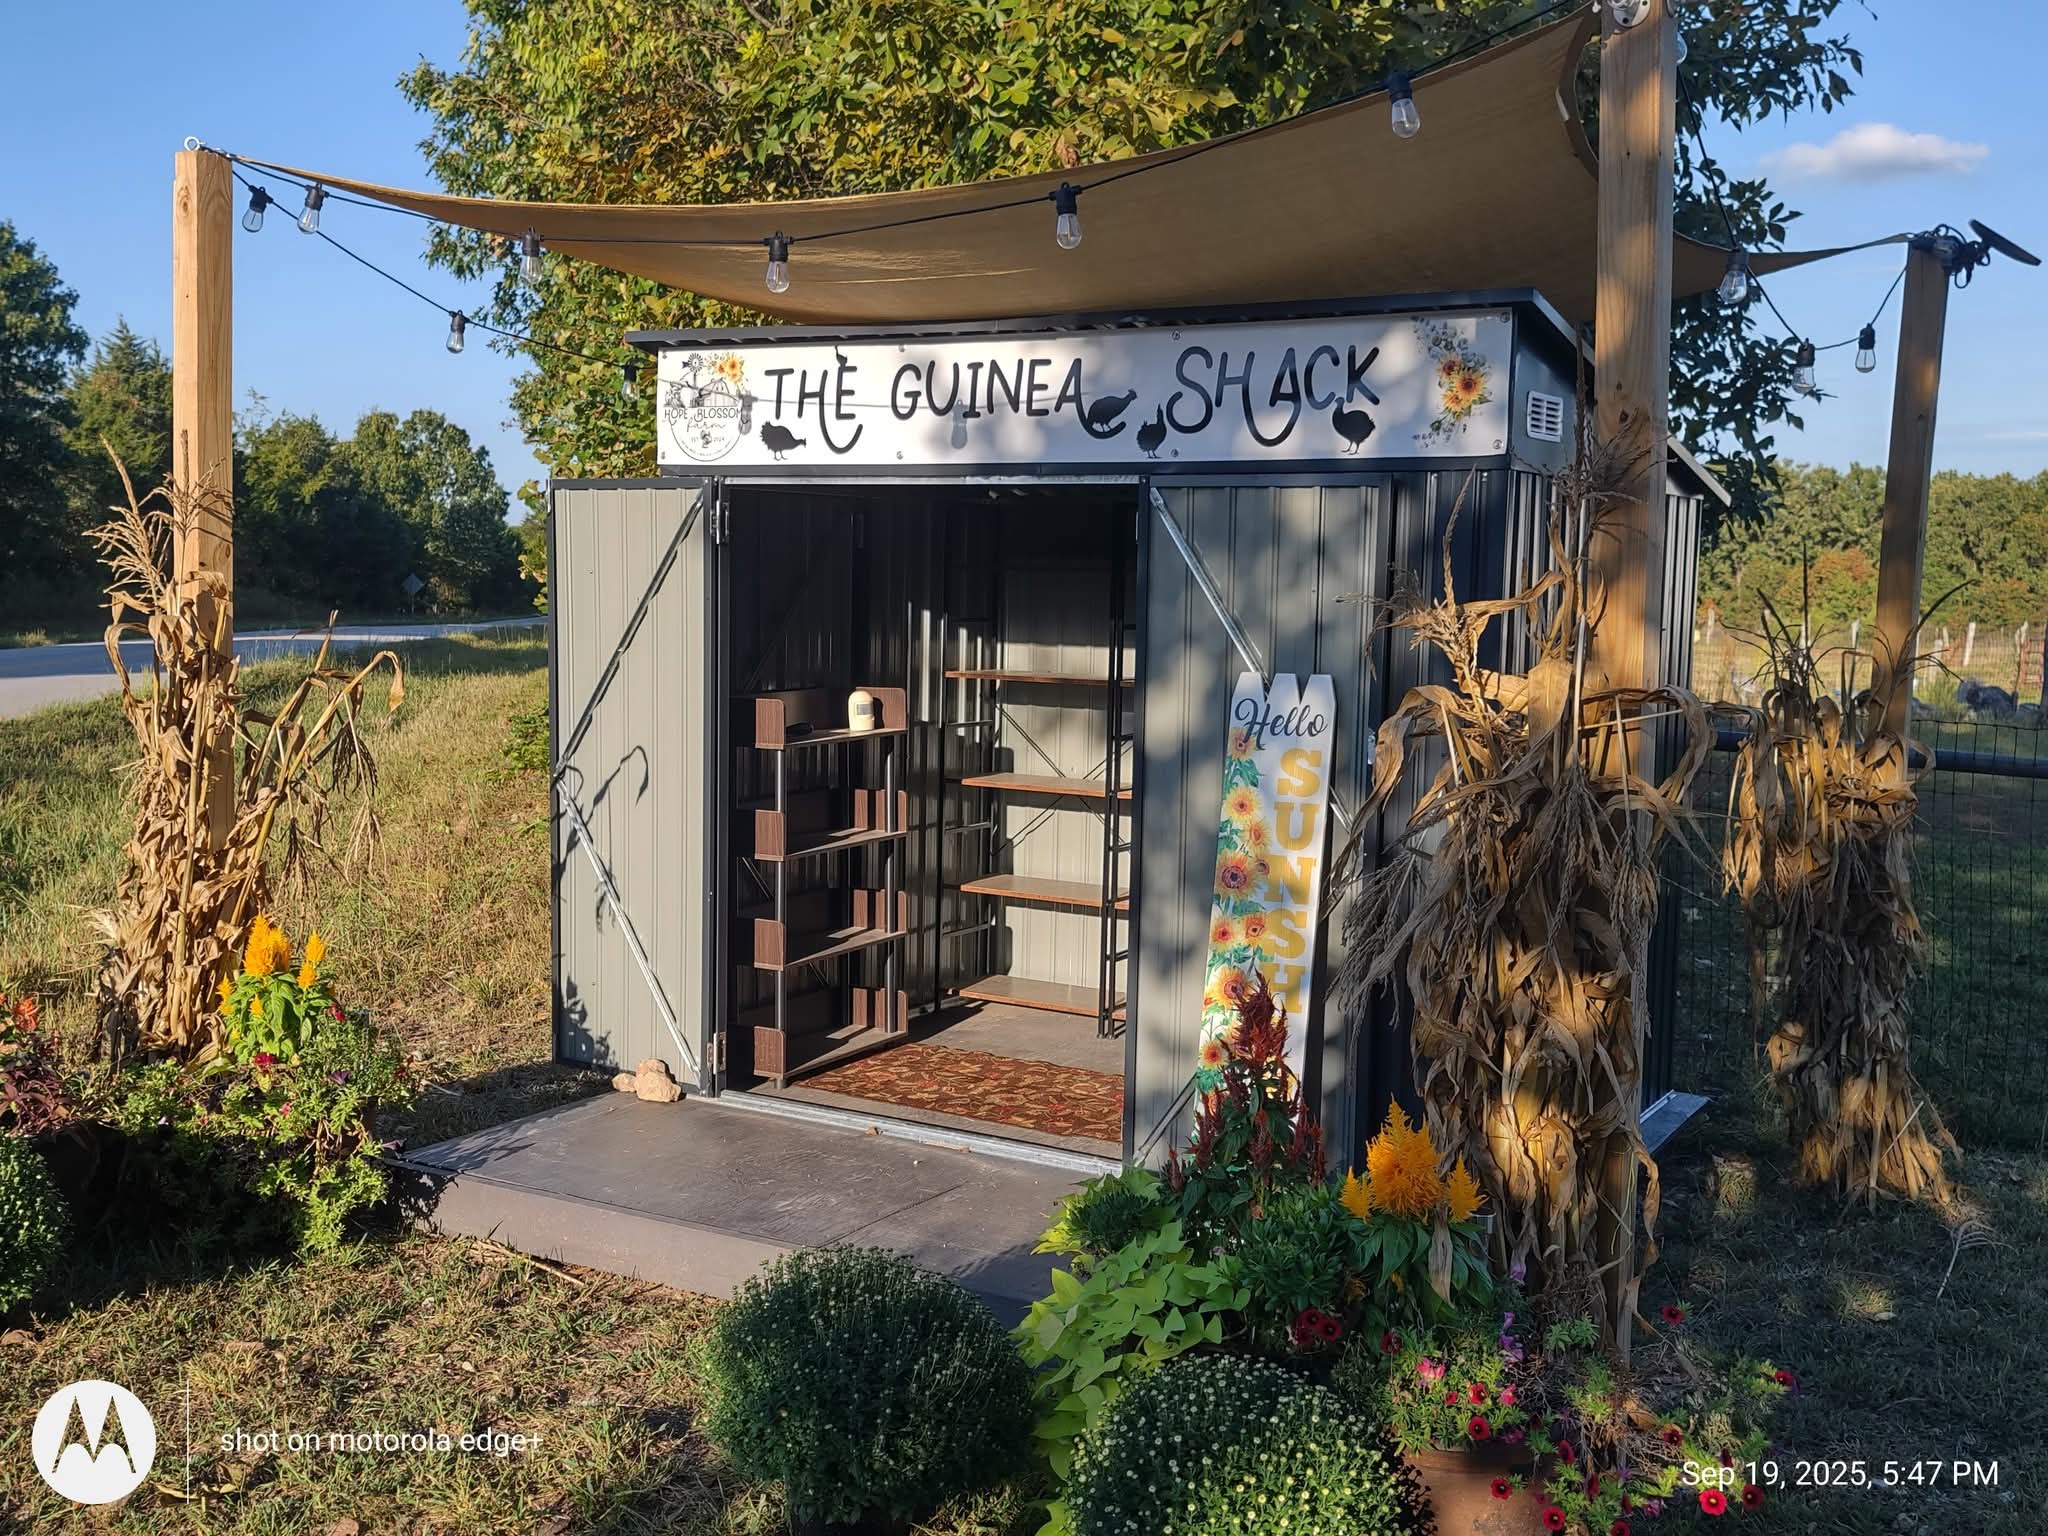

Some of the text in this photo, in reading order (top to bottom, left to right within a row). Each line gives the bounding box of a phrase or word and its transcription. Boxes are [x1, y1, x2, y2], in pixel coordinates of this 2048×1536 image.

[664, 408, 688, 426] HOPE
[764, 344, 1381, 454] THE GUINEA SHACK
[1235, 697, 1328, 750] Hello
